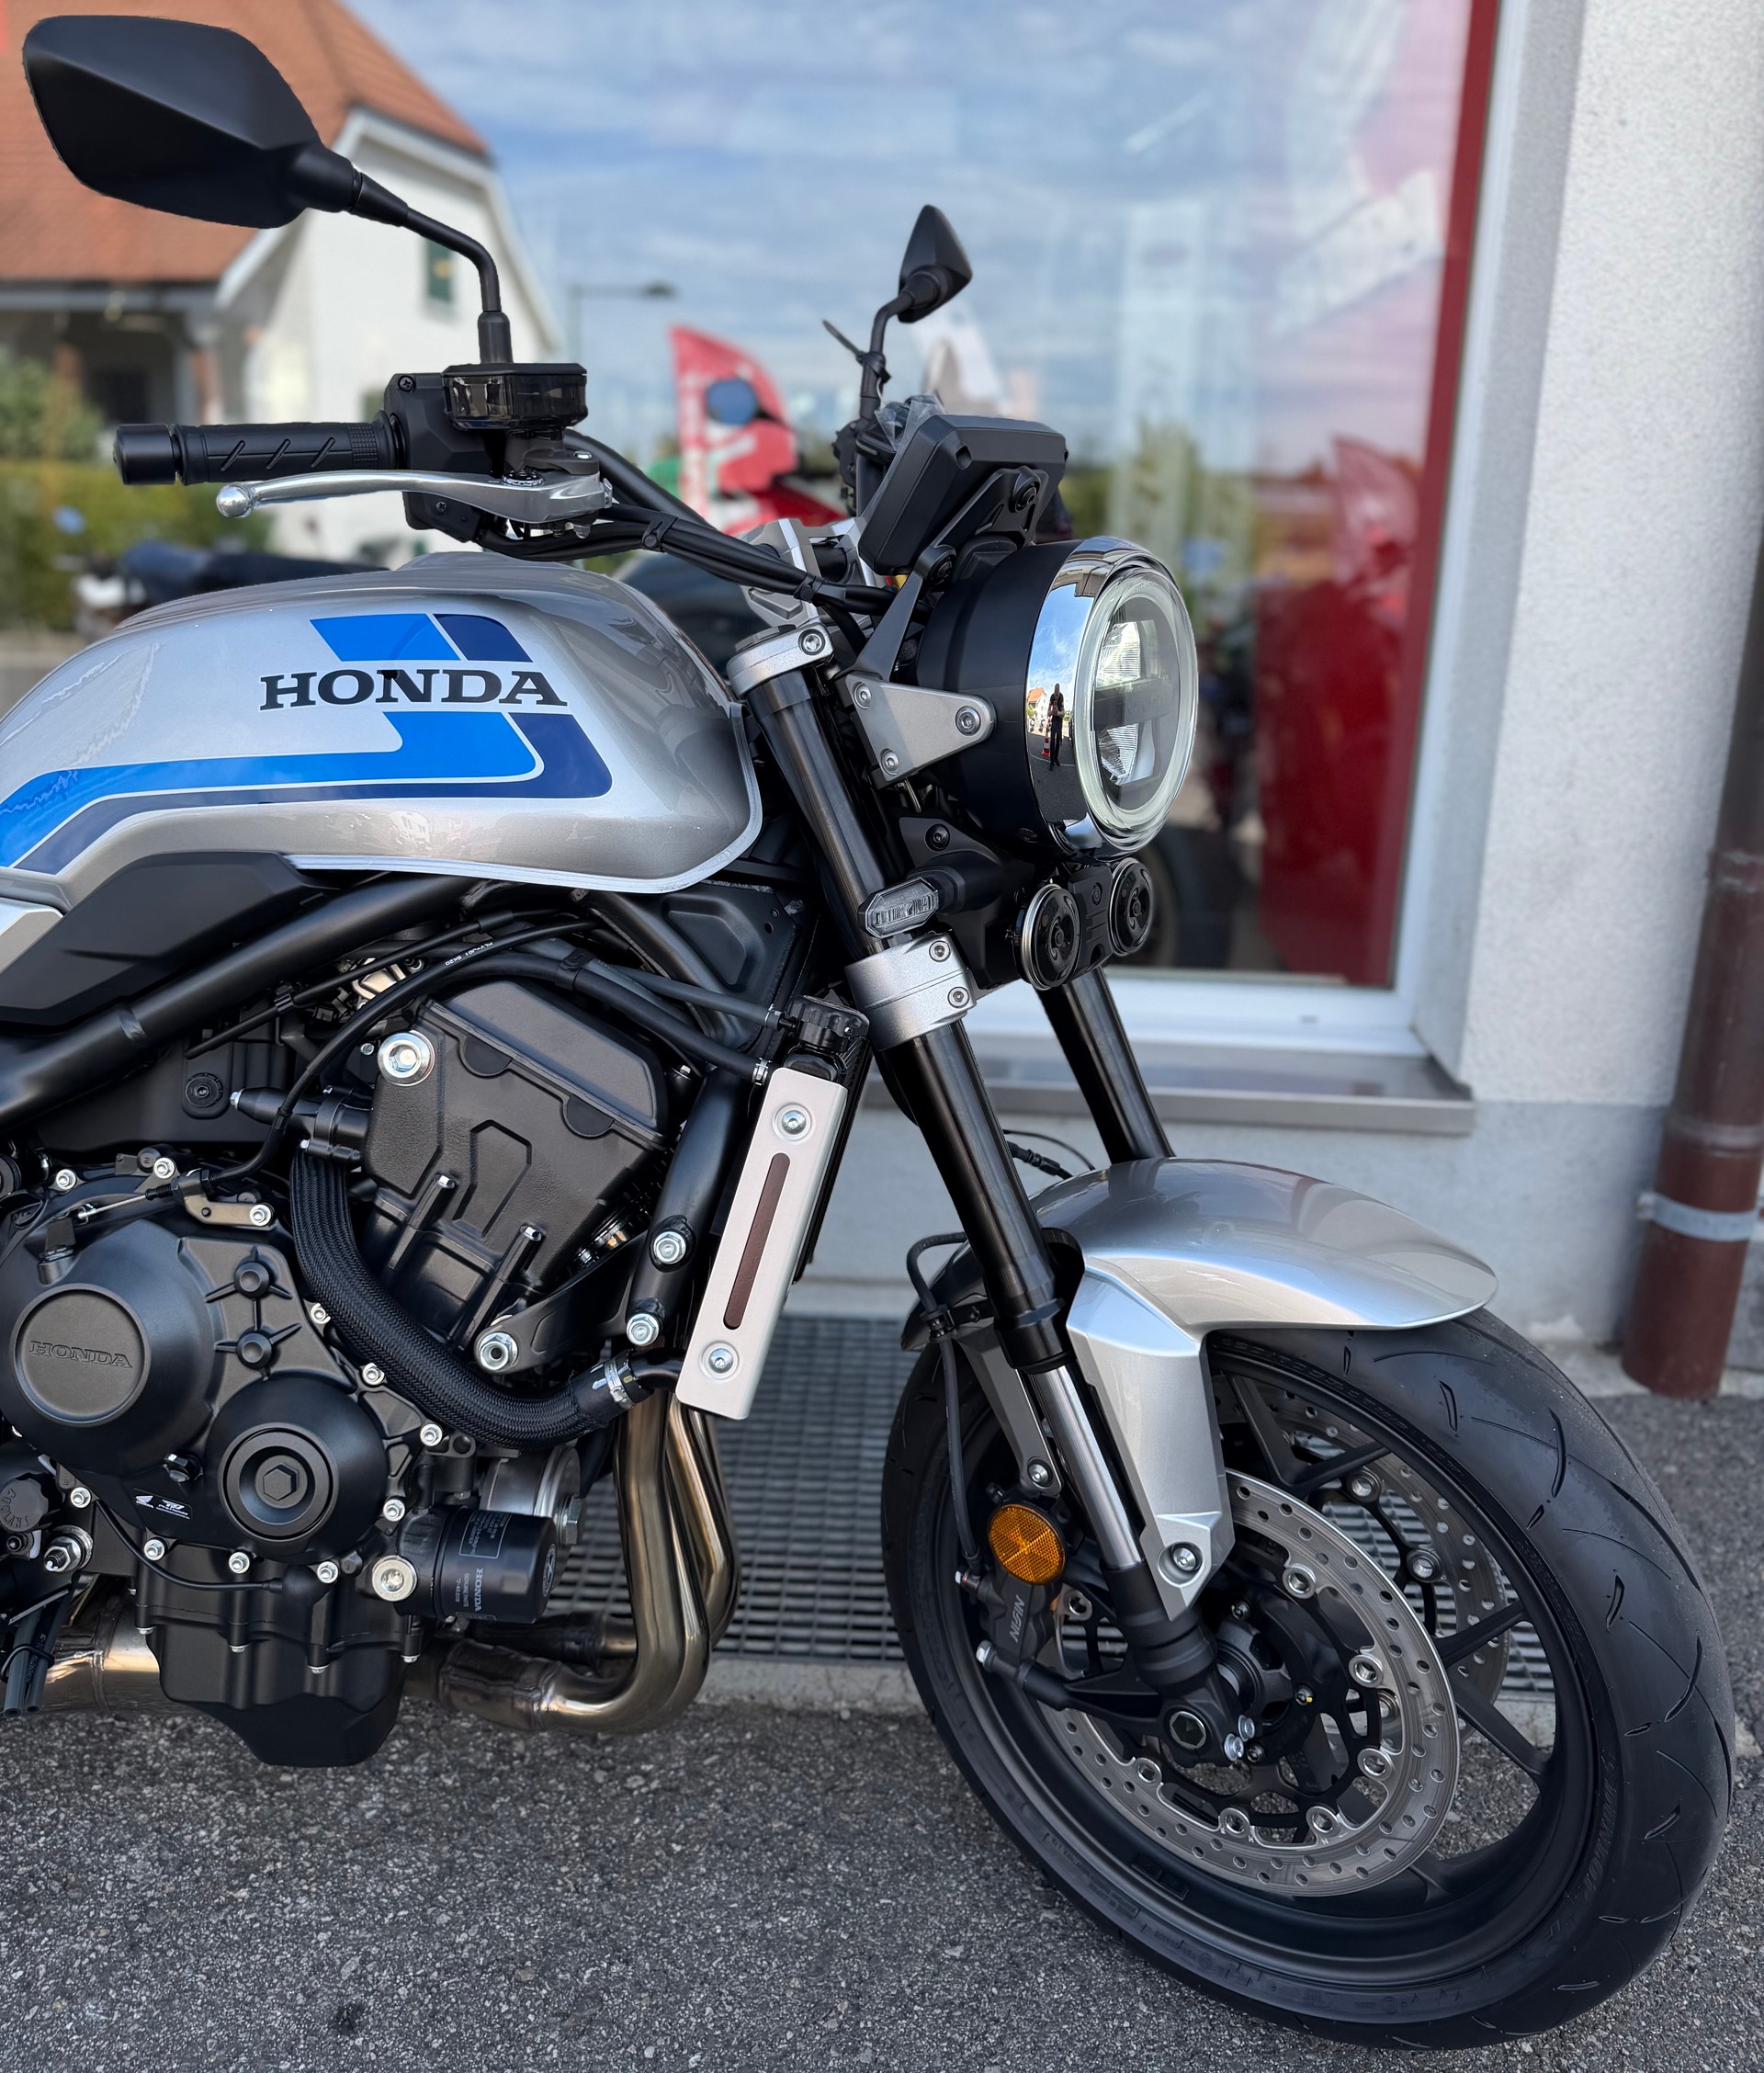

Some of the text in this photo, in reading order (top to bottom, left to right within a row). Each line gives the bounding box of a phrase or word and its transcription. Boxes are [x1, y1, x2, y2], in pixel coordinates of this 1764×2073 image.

[259, 669, 568, 711] HONDA
[30, 1341, 133, 1369] HONDA
[474, 1567, 483, 1612] HONDA
